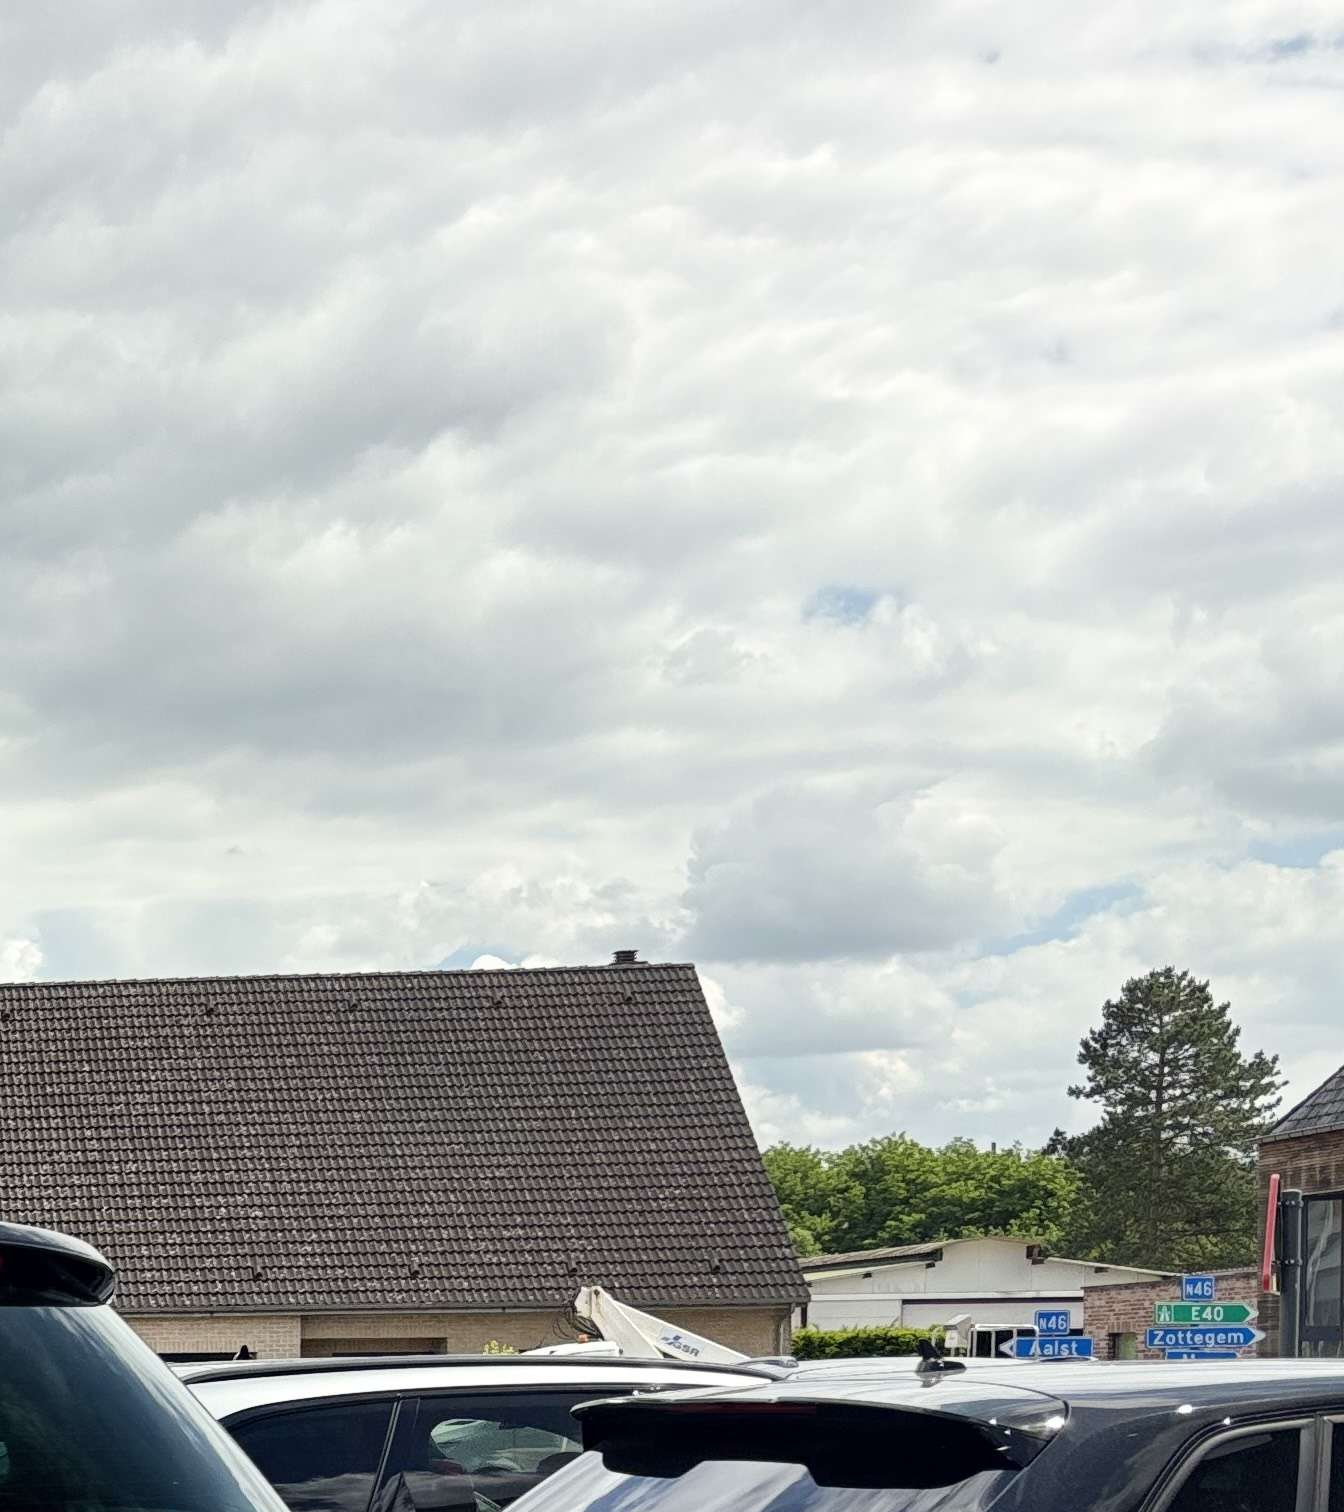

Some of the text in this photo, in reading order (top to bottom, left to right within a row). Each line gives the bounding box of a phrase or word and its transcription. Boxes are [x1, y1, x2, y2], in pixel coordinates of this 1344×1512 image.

[1186, 1281, 1213, 1297] N46
[1191, 1306, 1224, 1321] E40
[1039, 1315, 1067, 1331] N46
[1153, 1330, 1245, 1347] Zottegem
[1029, 1340, 1079, 1358] Aalst
